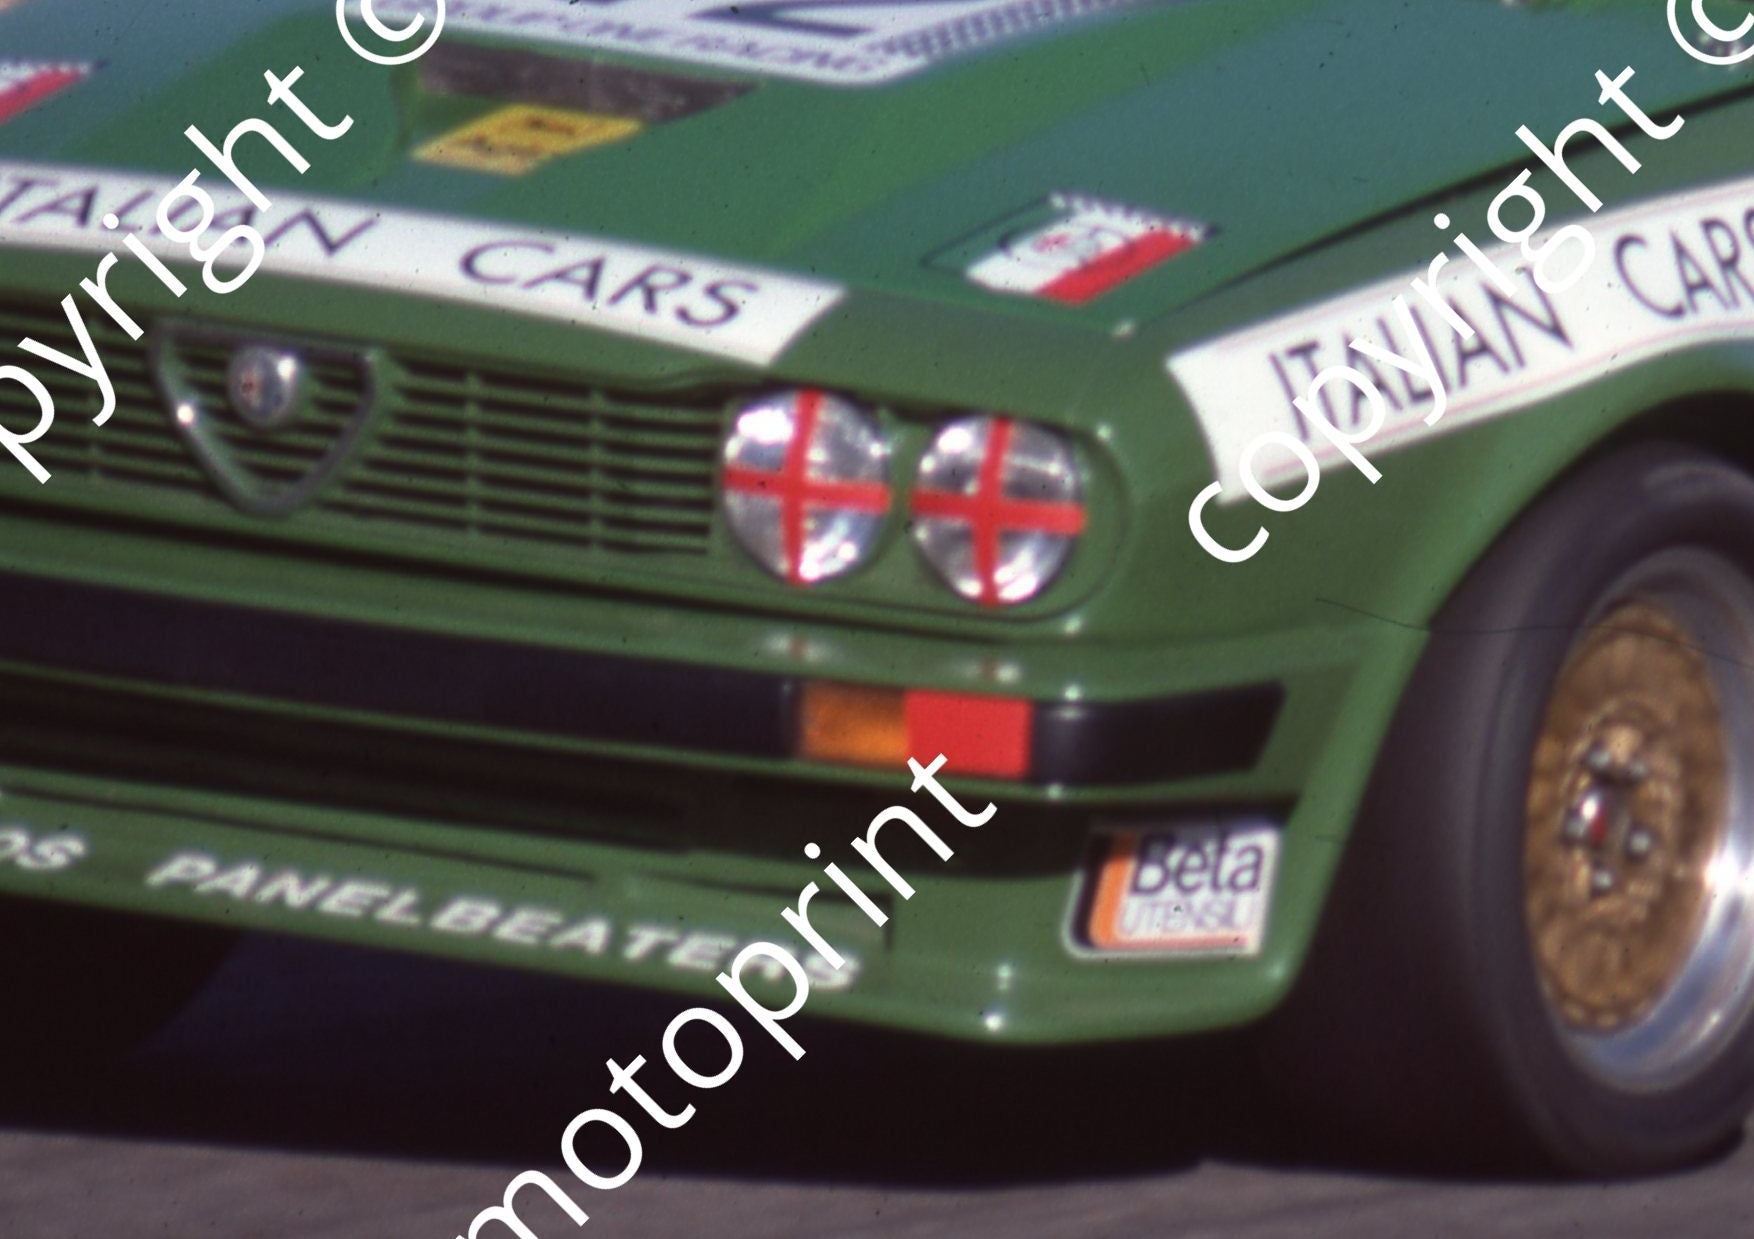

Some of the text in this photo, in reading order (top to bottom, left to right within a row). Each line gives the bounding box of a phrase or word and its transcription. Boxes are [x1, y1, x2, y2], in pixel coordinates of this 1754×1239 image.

[458, 239, 760, 330] CARS
[1268, 265, 1574, 442] ITALIAN
[1129, 830, 1265, 895] Beta
